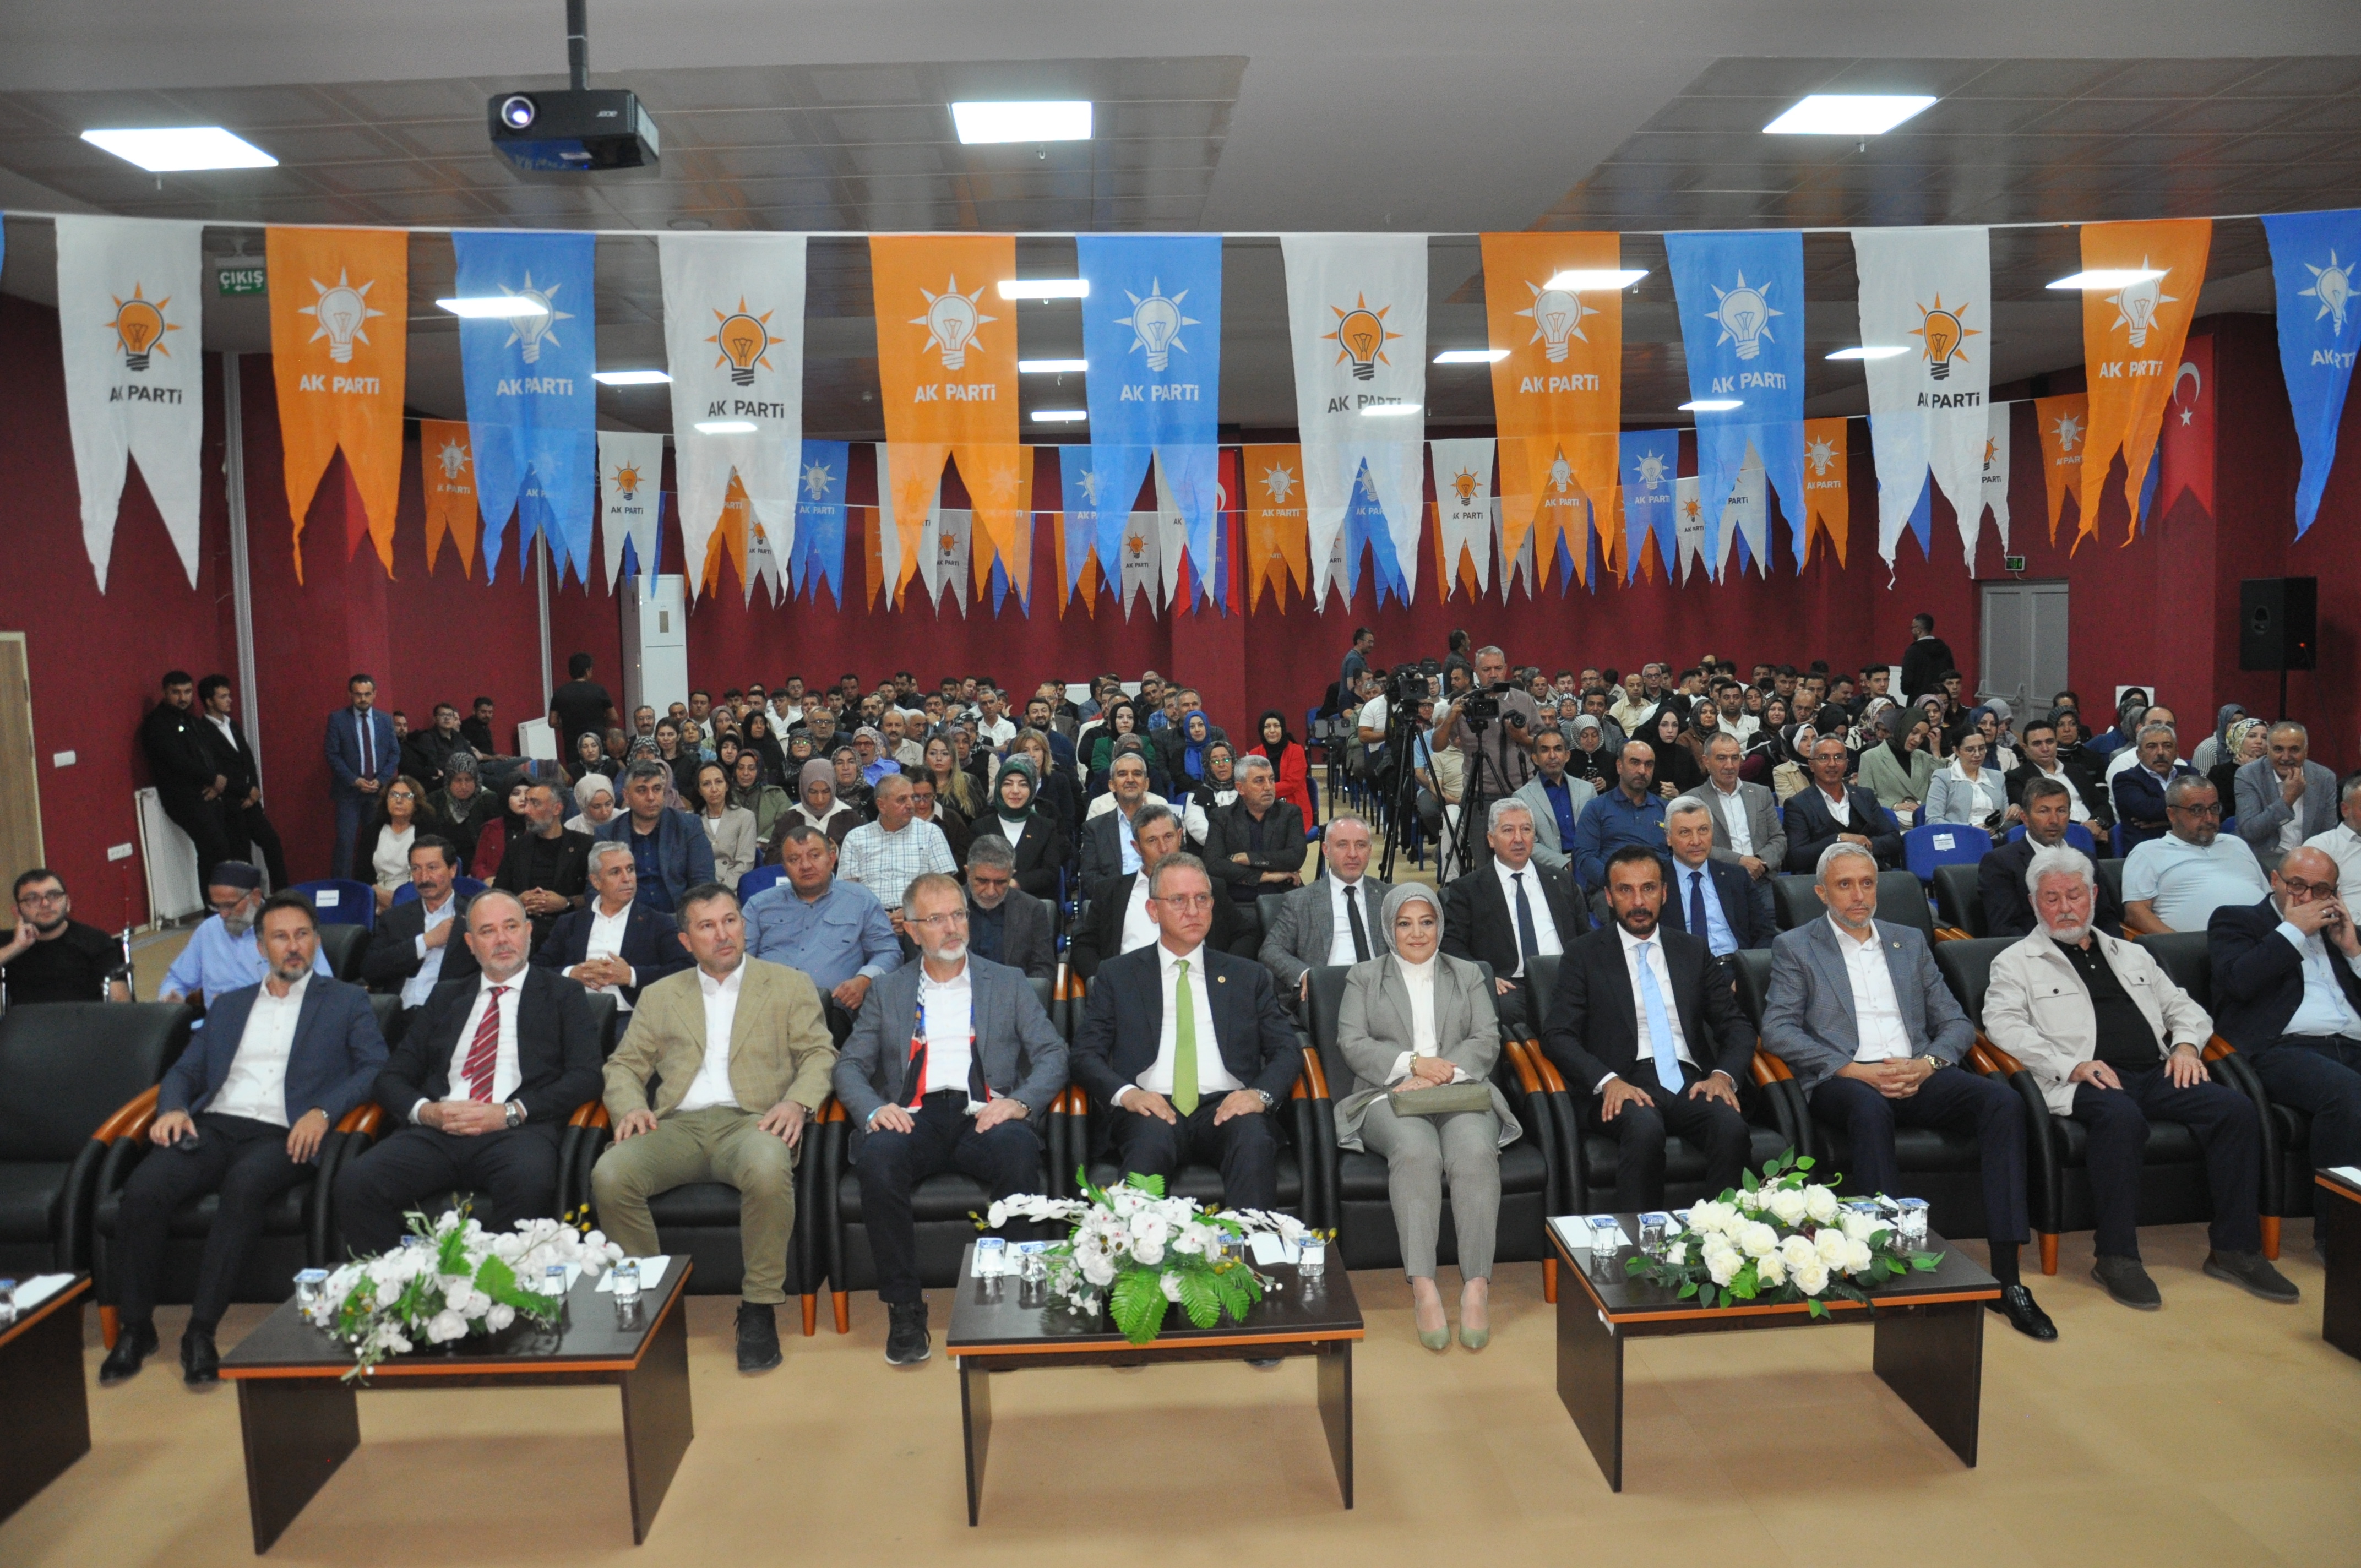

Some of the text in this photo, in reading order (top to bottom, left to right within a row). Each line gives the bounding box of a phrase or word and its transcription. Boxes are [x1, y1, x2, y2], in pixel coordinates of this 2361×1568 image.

[219, 270, 263, 289] ÇIKIŞ
[2099, 362, 2123, 378] AK
[300, 374, 325, 391] AK
[496, 379, 523, 395] AK
[1520, 377, 1544, 393] AK
[1712, 376, 1734, 393] AK
[110, 386, 123, 402] AK
[914, 384, 938, 403] AK
[1120, 385, 1144, 401] AK
[1917, 392, 1929, 407] AK
[708, 400, 727, 417] AK
[1328, 395, 1350, 413] AK
[526, 488, 538, 497] AK
[1635, 496, 1646, 504] AK
[799, 505, 810, 514] AK
[1356, 507, 1366, 515] AK
[1545, 499, 1557, 507] AK
